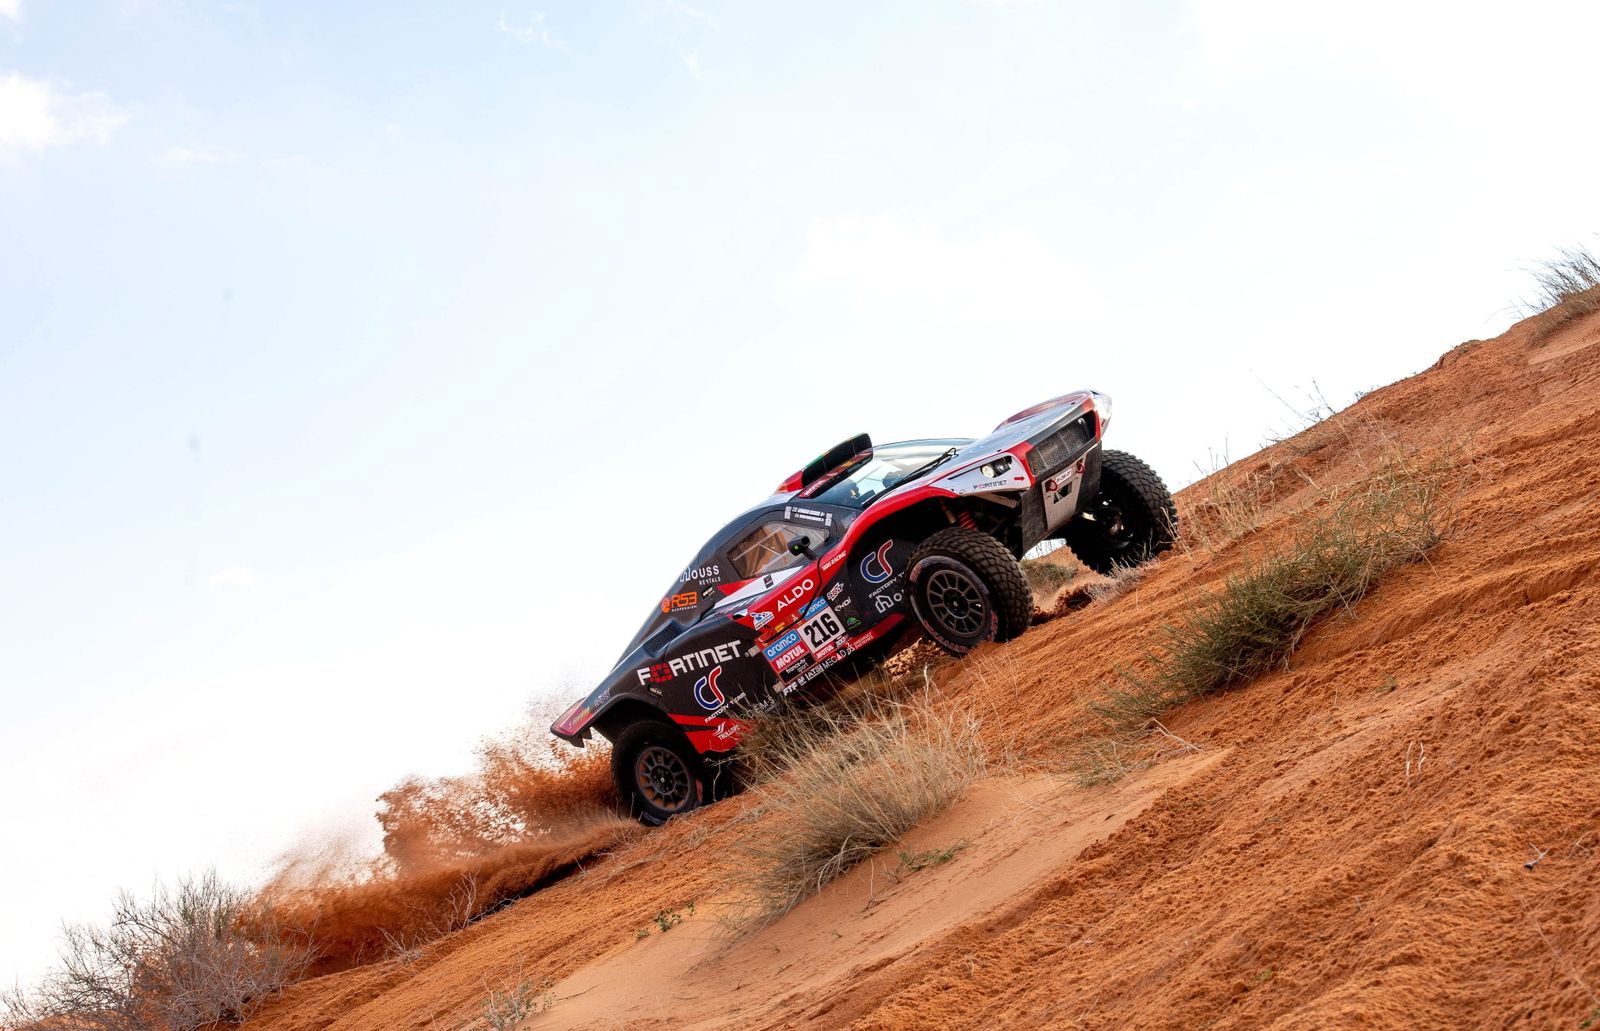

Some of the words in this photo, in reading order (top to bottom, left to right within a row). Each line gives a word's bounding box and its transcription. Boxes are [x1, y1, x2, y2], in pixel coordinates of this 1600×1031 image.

[973, 480, 1008, 490] FORTINET
[777, 579, 814, 612] ALDO
[868, 577, 897, 598] FACTORY
[803, 612, 840, 648] 216
[767, 633, 797, 657] aramco
[775, 645, 805, 669] MOTUL
[816, 644, 835, 659] MOTUL
[636, 640, 741, 686] FORTINET
[704, 703, 730, 723] FACTORY
